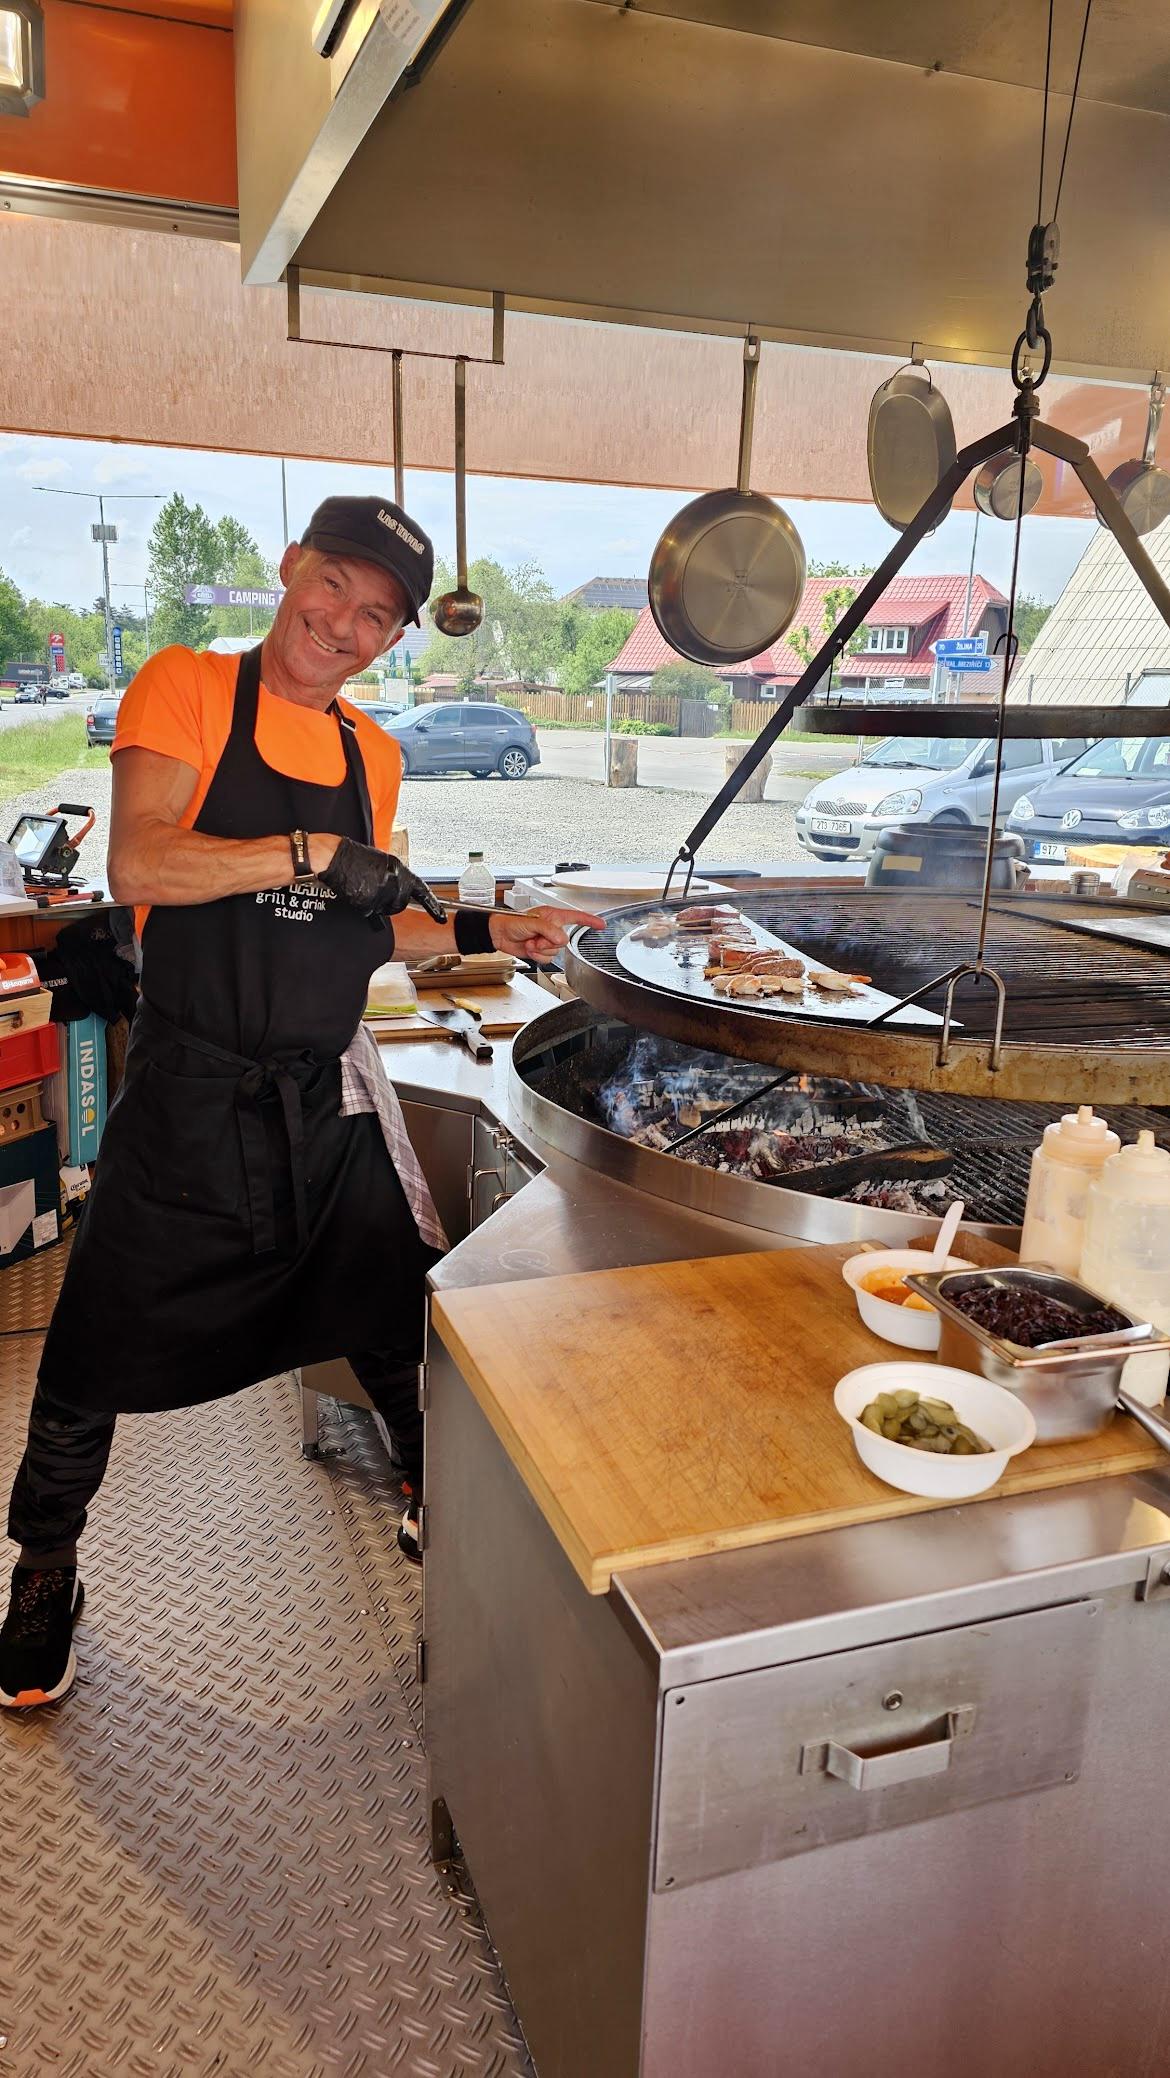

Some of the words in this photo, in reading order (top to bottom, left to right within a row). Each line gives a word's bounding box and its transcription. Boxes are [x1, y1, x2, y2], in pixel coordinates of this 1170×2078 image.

[377, 509, 398, 530] LAS
[396, 523, 425, 555] TAPAS
[229, 590, 276, 606] CAMPING
[955, 641, 973, 650] ŽILINA
[816, 820, 828, 830] 2T3
[1042, 844, 1058, 855] 9T7
[255, 892, 286, 905] grill
[289, 895, 300, 908] &
[301, 899, 327, 911] drink
[274, 906, 314, 922] studio
[79, 1039, 96, 1137] INDASOL
[70, 1179, 89, 1192] Corona
